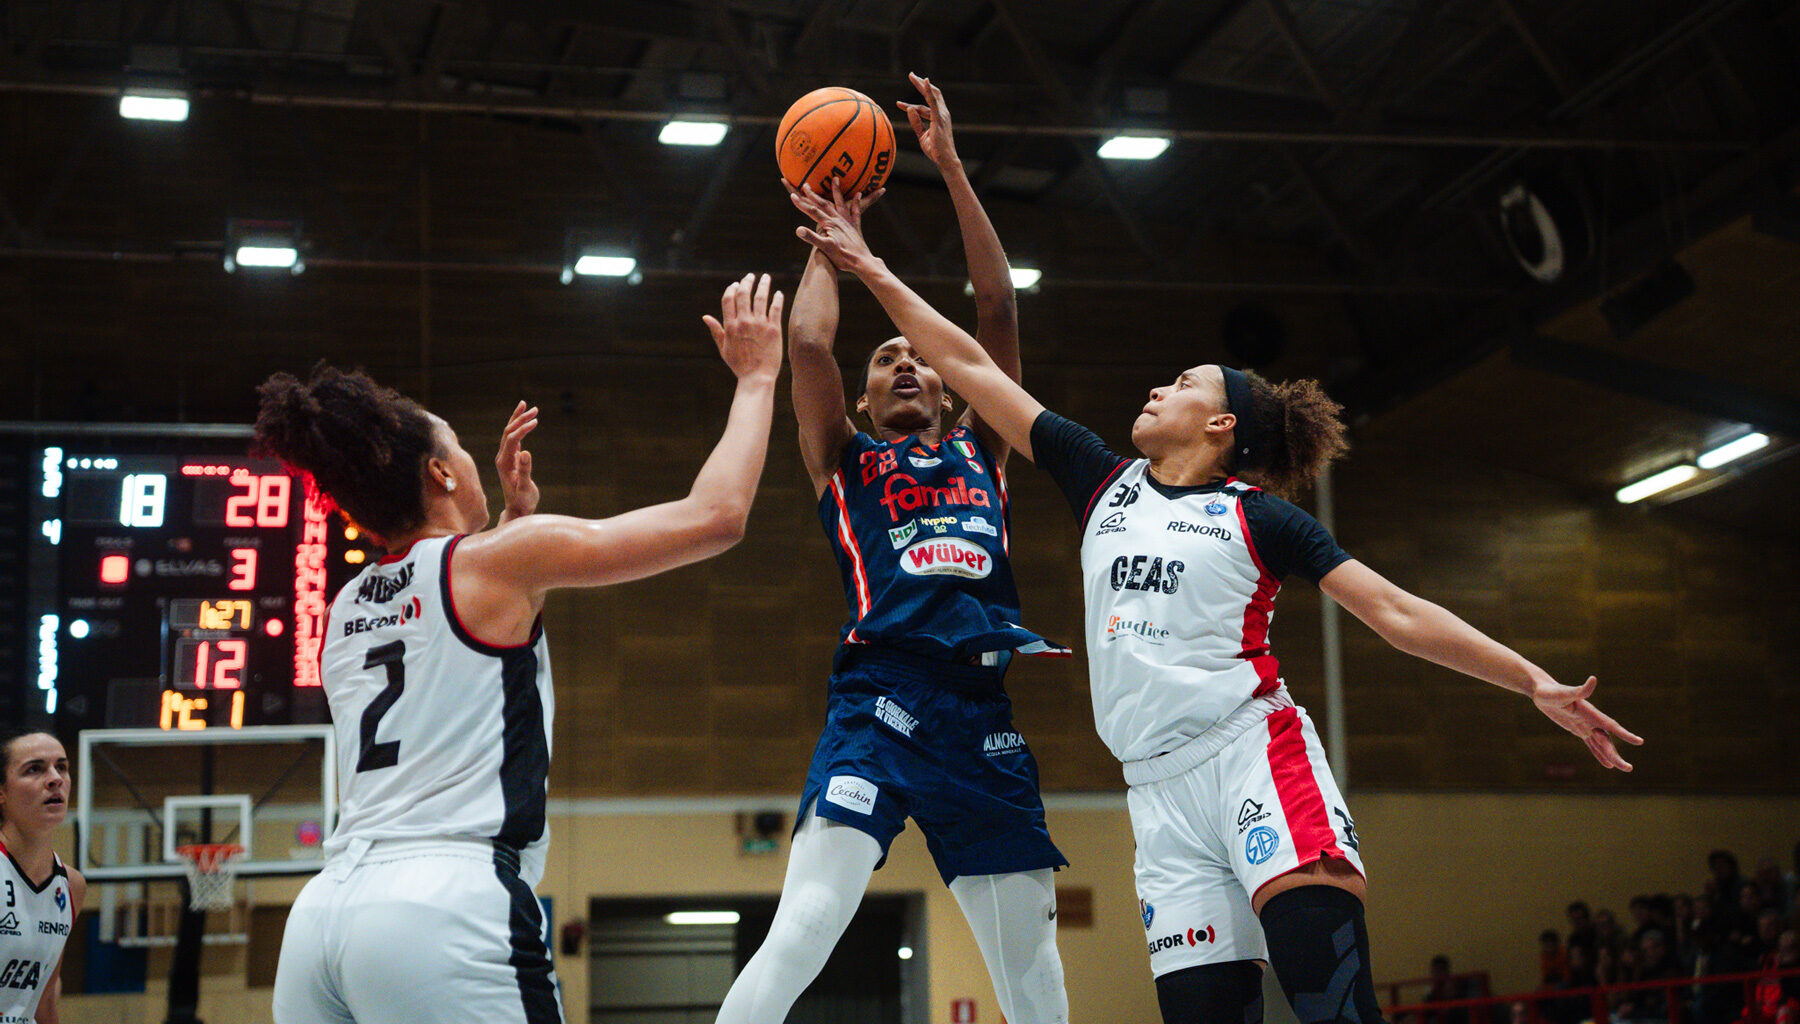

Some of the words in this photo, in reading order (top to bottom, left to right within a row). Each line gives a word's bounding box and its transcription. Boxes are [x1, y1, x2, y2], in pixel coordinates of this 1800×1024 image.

[119, 473, 167, 527] 18
[225, 475, 291, 527] 28
[880, 473, 991, 522] famila
[1108, 482, 1141, 508] 36
[891, 521, 917, 543] HDI
[921, 516, 958, 527] HYPNO
[1166, 520, 1232, 542] RENORD
[229, 548, 257, 590] 3
[908, 543, 987, 572] Wüber
[1110, 555, 1185, 595] GEAS
[344, 614, 399, 637] BELFOR
[1107, 615, 1170, 639] giudice
[194, 640, 247, 690] 12
[356, 639, 406, 773] 2
[983, 732, 1026, 752] ALMORA
[830, 784, 871, 805] Cecchin
[1333, 806, 1359, 852] 3
[1149, 933, 1184, 955] ELFOR
[0, 958, 41, 991] GEA
